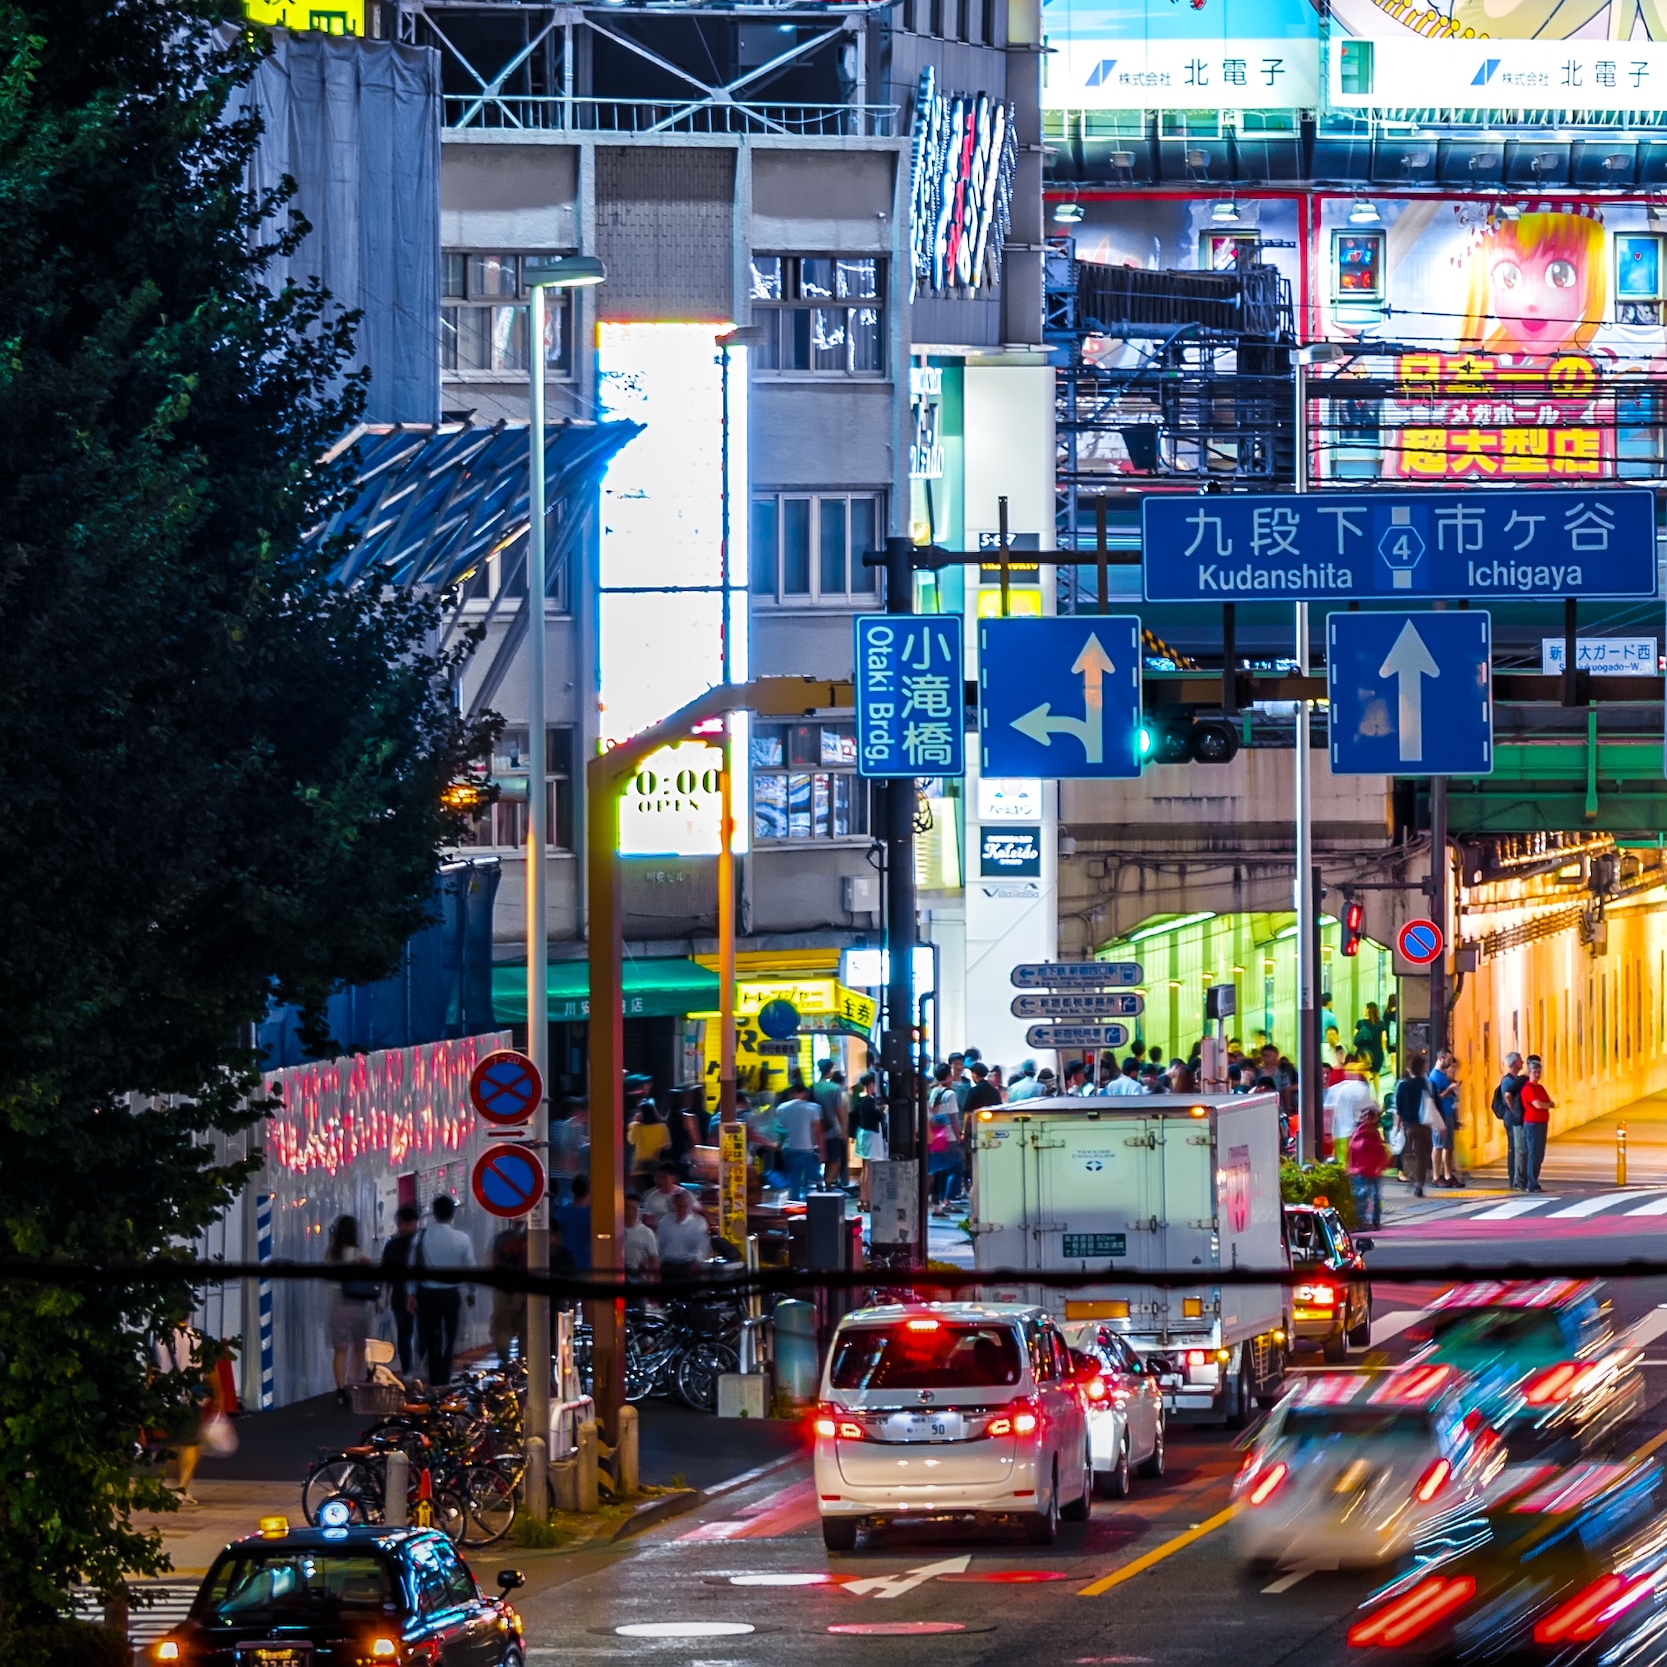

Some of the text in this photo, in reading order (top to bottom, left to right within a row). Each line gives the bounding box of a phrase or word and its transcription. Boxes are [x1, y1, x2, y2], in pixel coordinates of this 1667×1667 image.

[1118, 56, 1287, 88] 株式会社 北電子
[1501, 59, 1652, 89] 株式会社 北電子
[1398, 426, 1603, 478] 超大型店
[1184, 507, 1367, 557] 九段下
[1392, 534, 1411, 562] 4
[1199, 559, 1583, 594] Kudanshita Ichigaya
[1549, 643, 1652, 662] 新大ガード西
[865, 626, 894, 769] Otaki Brdg.
[900, 627, 954, 768] 小滝橋
[636, 799, 702, 814] OPEN
[981, 842, 1040, 861] Kaleido
[841, 997, 872, 1024] 金券
